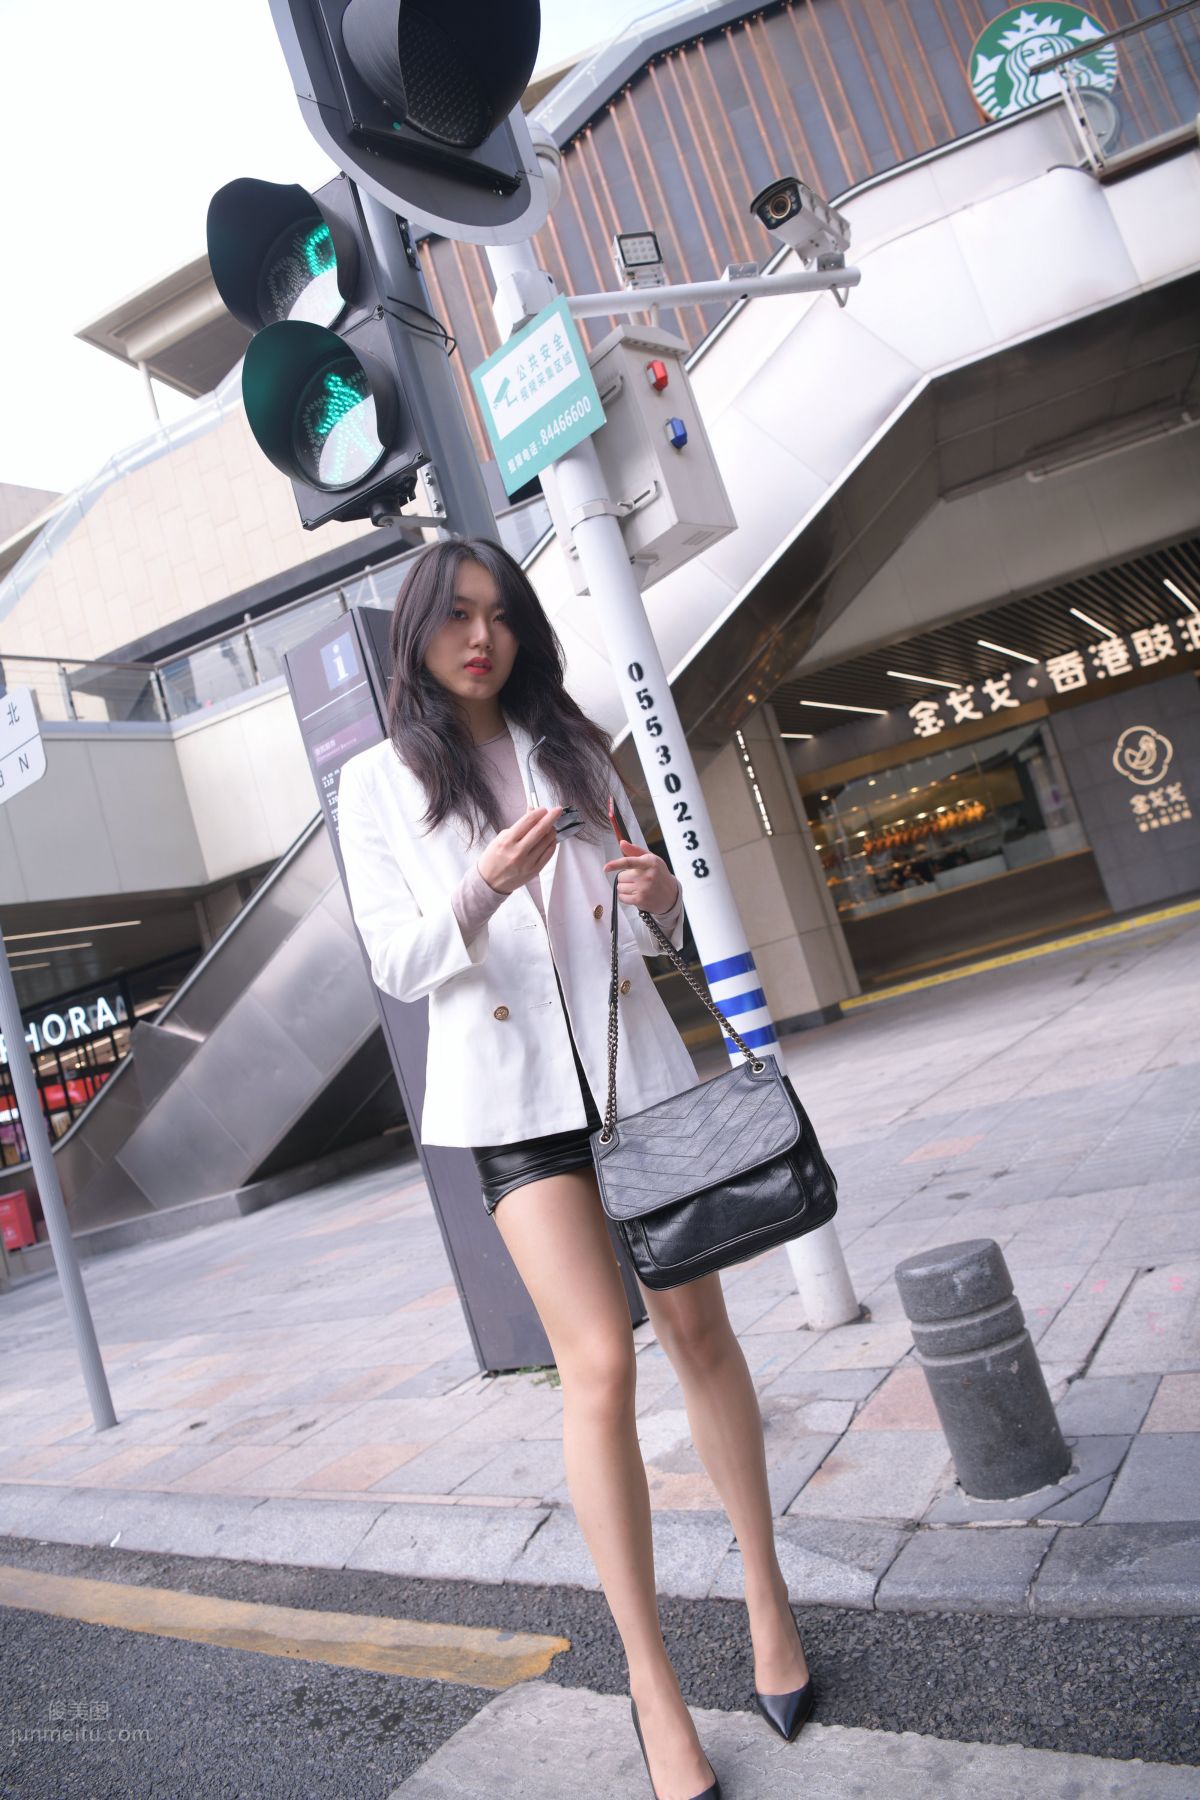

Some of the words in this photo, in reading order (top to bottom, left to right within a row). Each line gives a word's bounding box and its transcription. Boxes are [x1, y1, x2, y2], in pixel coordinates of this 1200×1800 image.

[517, 334, 564, 381] 公共安全
[6, 701, 20, 727] 北
[18, 753, 30, 774] N
[627, 661, 710, 879] 05530238
[0, 996, 118, 1063] HORA
